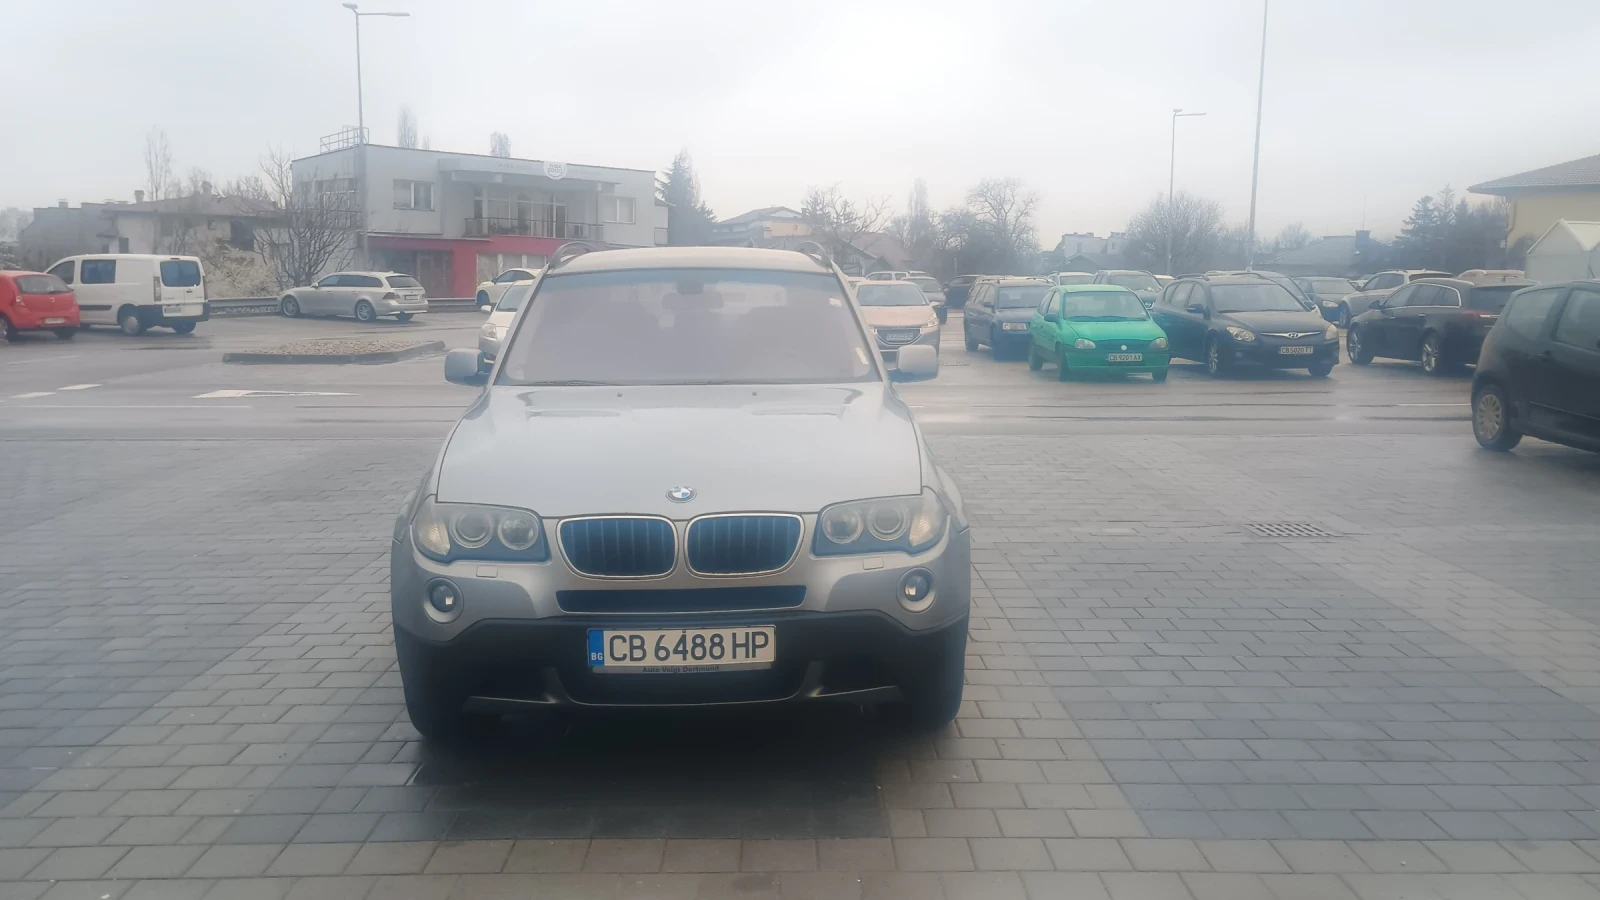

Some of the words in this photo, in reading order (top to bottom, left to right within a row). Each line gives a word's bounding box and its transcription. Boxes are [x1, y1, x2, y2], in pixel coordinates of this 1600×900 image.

[609, 634, 647, 662] CB
[654, 633, 725, 662] 6488
[731, 631, 769, 660] HP
[590, 652, 604, 661] BG
[661, 666, 680, 674] Voigt
[682, 665, 720, 673] Dortmund
